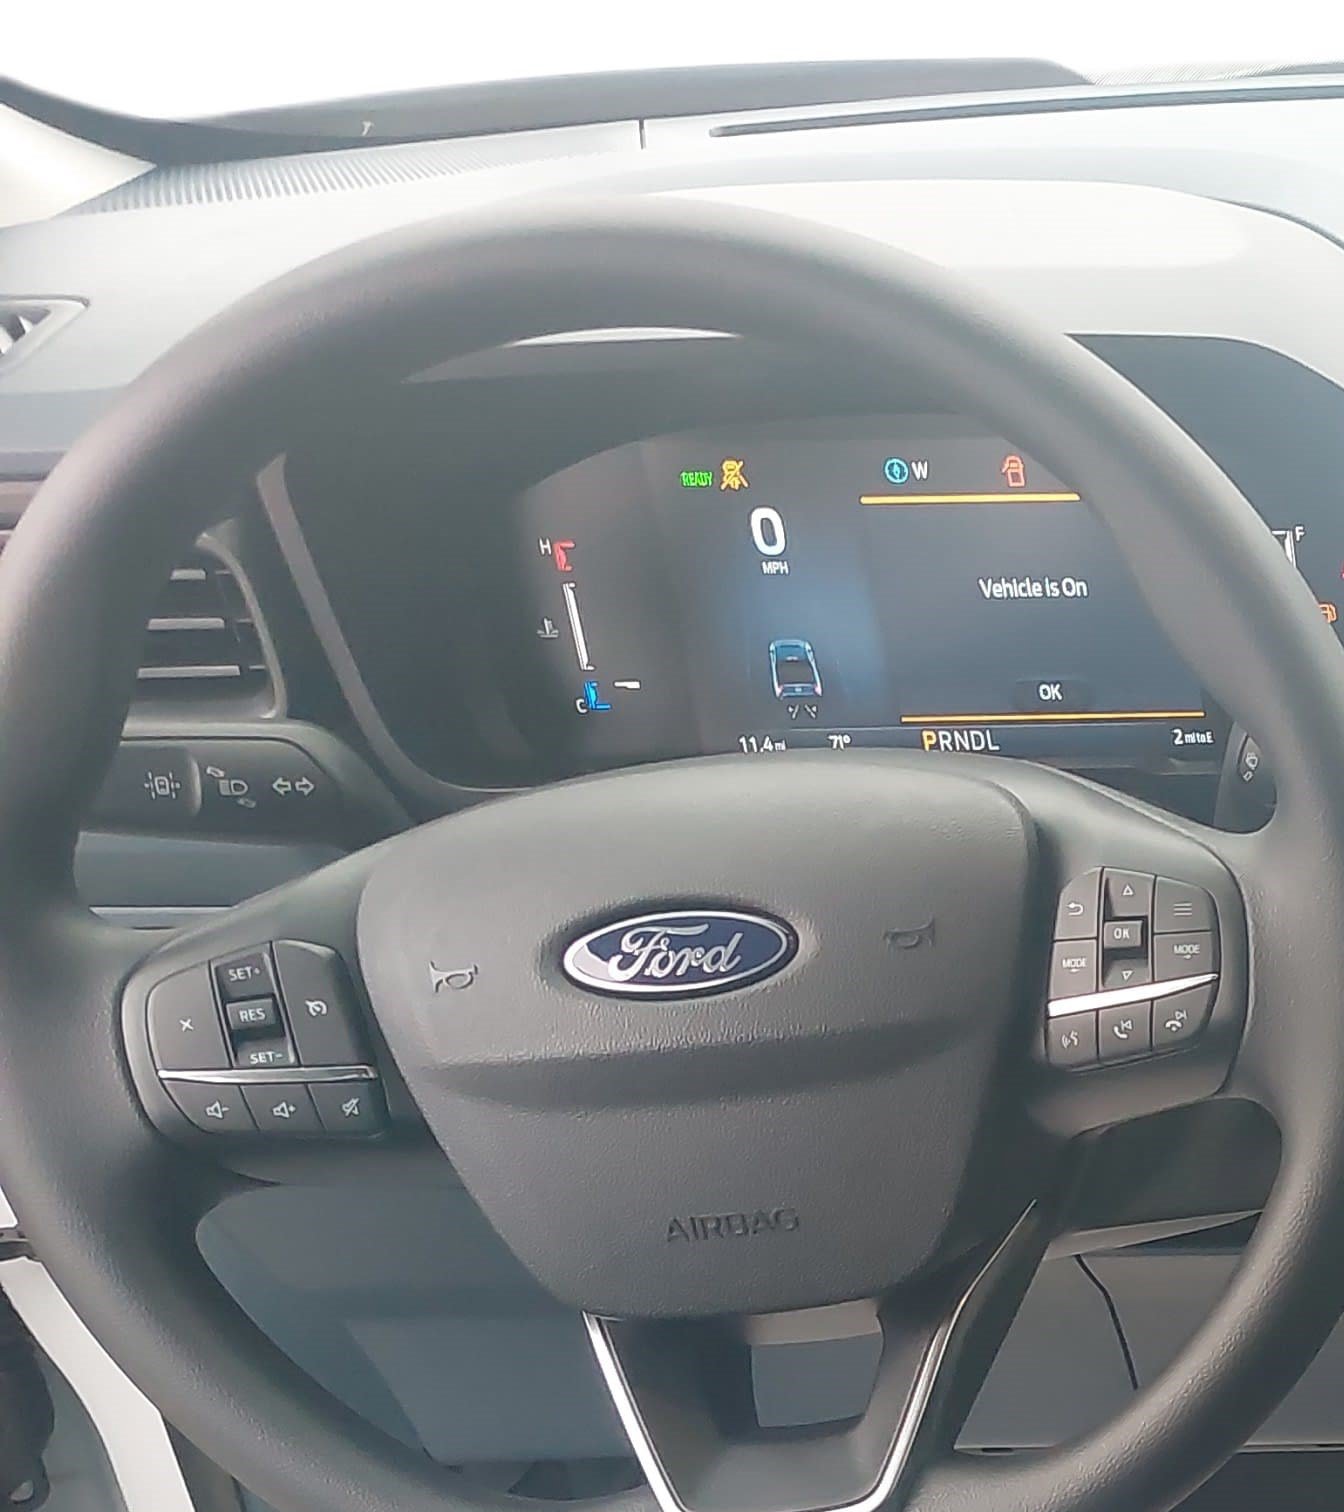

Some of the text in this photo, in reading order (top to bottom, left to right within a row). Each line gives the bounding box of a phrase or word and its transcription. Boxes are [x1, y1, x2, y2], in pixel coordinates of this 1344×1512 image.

[911, 460, 929, 481] W
[680, 471, 713, 488] READY
[750, 506, 787, 556] 0
[1294, 525, 1306, 542] F
[538, 537, 552, 555] H
[762, 560, 790, 575] MPH
[978, 576, 1044, 599] Vehicle
[1061, 576, 1089, 598] On
[1038, 683, 1063, 702] OK
[575, 698, 588, 714] C
[922, 729, 1000, 752] PRNDL
[1172, 728, 1184, 745] 2
[1206, 731, 1214, 743] E
[1114, 928, 1130, 940] OK
[607, 923, 745, 982] Ford
[1173, 944, 1201, 954] MODE
[1062, 957, 1087, 968] MODE
[239, 1008, 266, 1022] RES
[666, 1207, 800, 1243] AIRBAG
